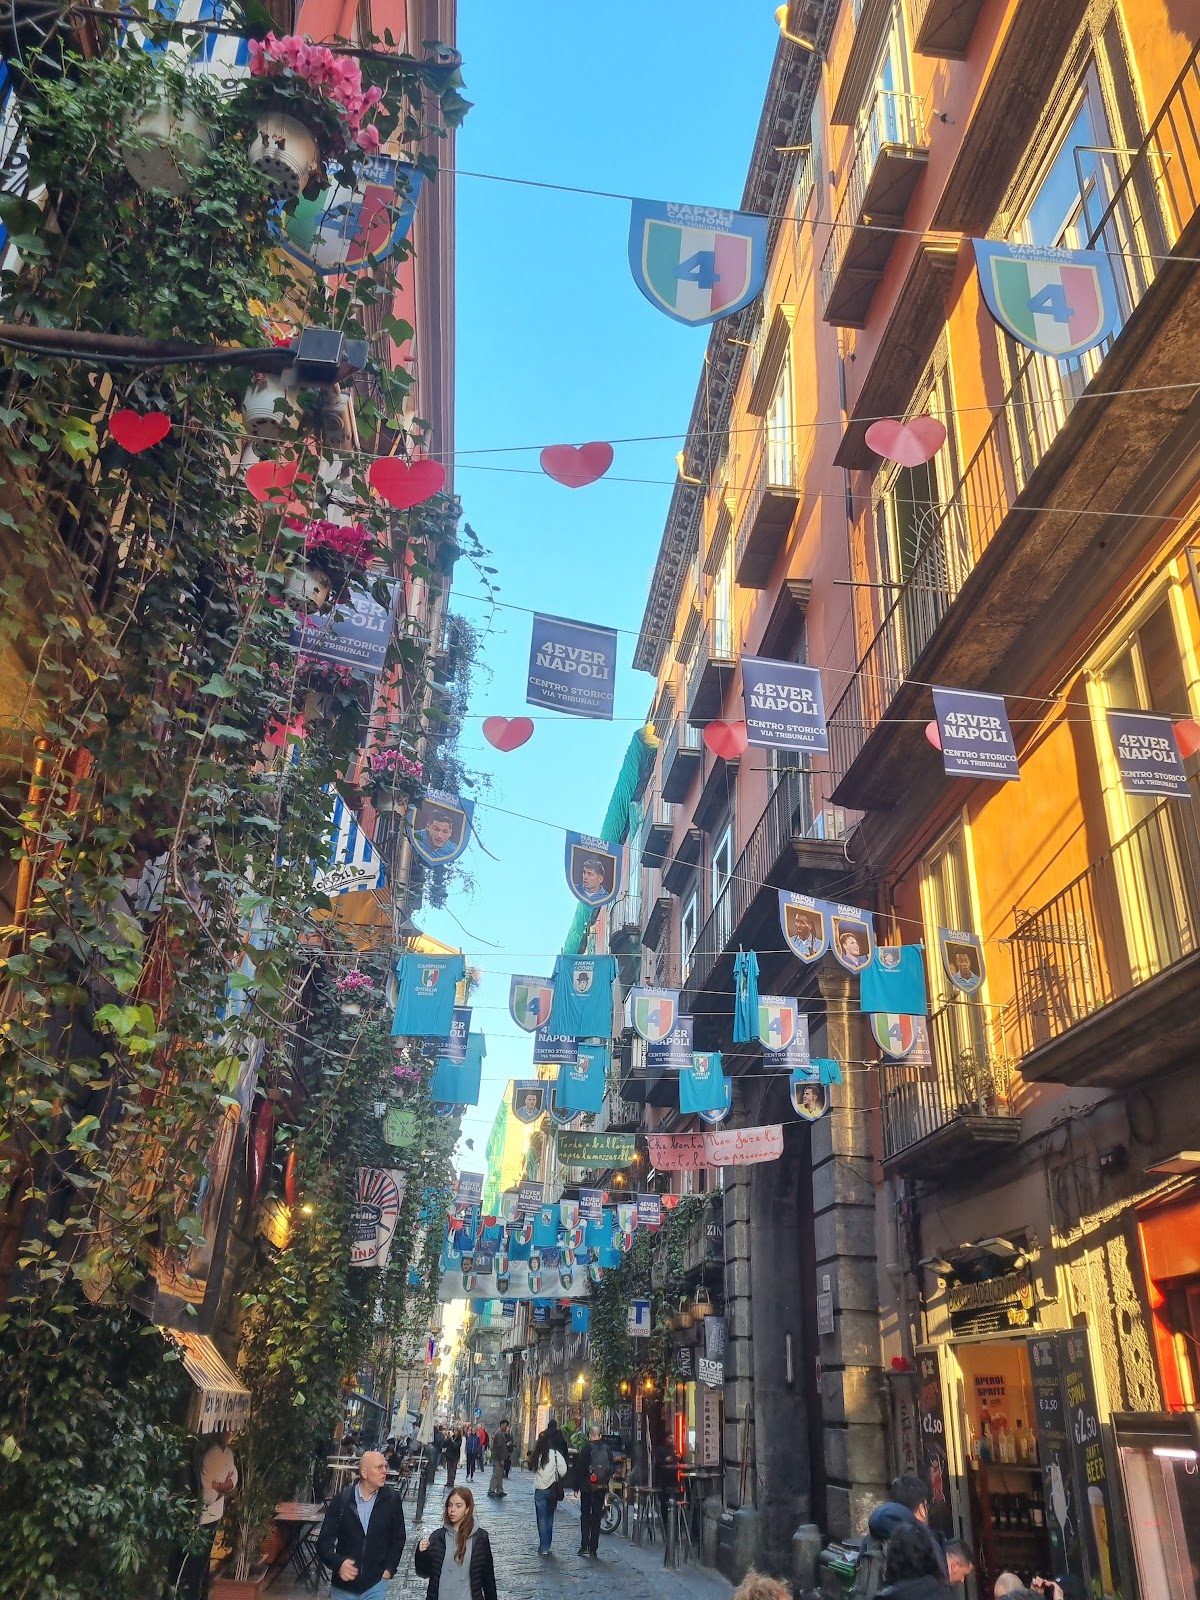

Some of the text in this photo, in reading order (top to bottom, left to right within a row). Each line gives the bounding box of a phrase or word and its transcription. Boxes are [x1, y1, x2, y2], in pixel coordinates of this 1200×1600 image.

[666, 202, 734, 221] NAPOLI
[667, 211, 732, 228] CAMPIONE
[687, 221, 729, 233] TRIBUNALI
[1008, 246, 1074, 259] CAMPIONE
[1029, 254, 1072, 264] TRIBUNALI
[671, 250, 721, 290] 4
[1026, 283, 1075, 324] 4
[307, 637, 370, 658] VIA TRIBUNALI
[340, 636, 387, 654] STORICO
[541, 641, 606, 666] 4EVER
[536, 652, 610, 680] NAPOLI
[529, 676, 614, 700] CENTRO STORICO
[753, 682, 813, 701] 4EVER
[542, 689, 601, 706] VIA TRIBUNALI
[750, 694, 819, 715] NAPOLI
[747, 719, 826, 735] CENTRO STORICO
[945, 712, 1002, 730] 4EVER
[775, 731, 815, 741] TRIBUNALI
[943, 724, 1008, 743] NAPOLI
[1119, 734, 1170, 751] 4EVER
[943, 748, 1017, 762] CENTRO STORICO
[969, 759, 1007, 768] TRIBUNALI
[1118, 746, 1178, 764] NAPOLI
[1120, 770, 1187, 782] CENTRO STORICO
[1145, 779, 1178, 789] TRIBUNALI
[790, 892, 816, 904] NAPOLI
[837, 904, 862, 915] NAPOLI
[948, 929, 970, 938] NAPOLI
[769, 1016, 783, 1036] 4
[889, 1023, 903, 1041] 4
[538, 1033, 576, 1043] NAPOLI
[648, 1137, 667, 1150] Che
[707, 1133, 731, 1146] Non
[764, 1130, 778, 1141] la
[698, 1358, 723, 1371] STOP
[975, 1376, 1005, 1386] APEROL
[977, 1387, 1005, 1396] SPRITZ
[1086, 1459, 1106, 1483] BEER
